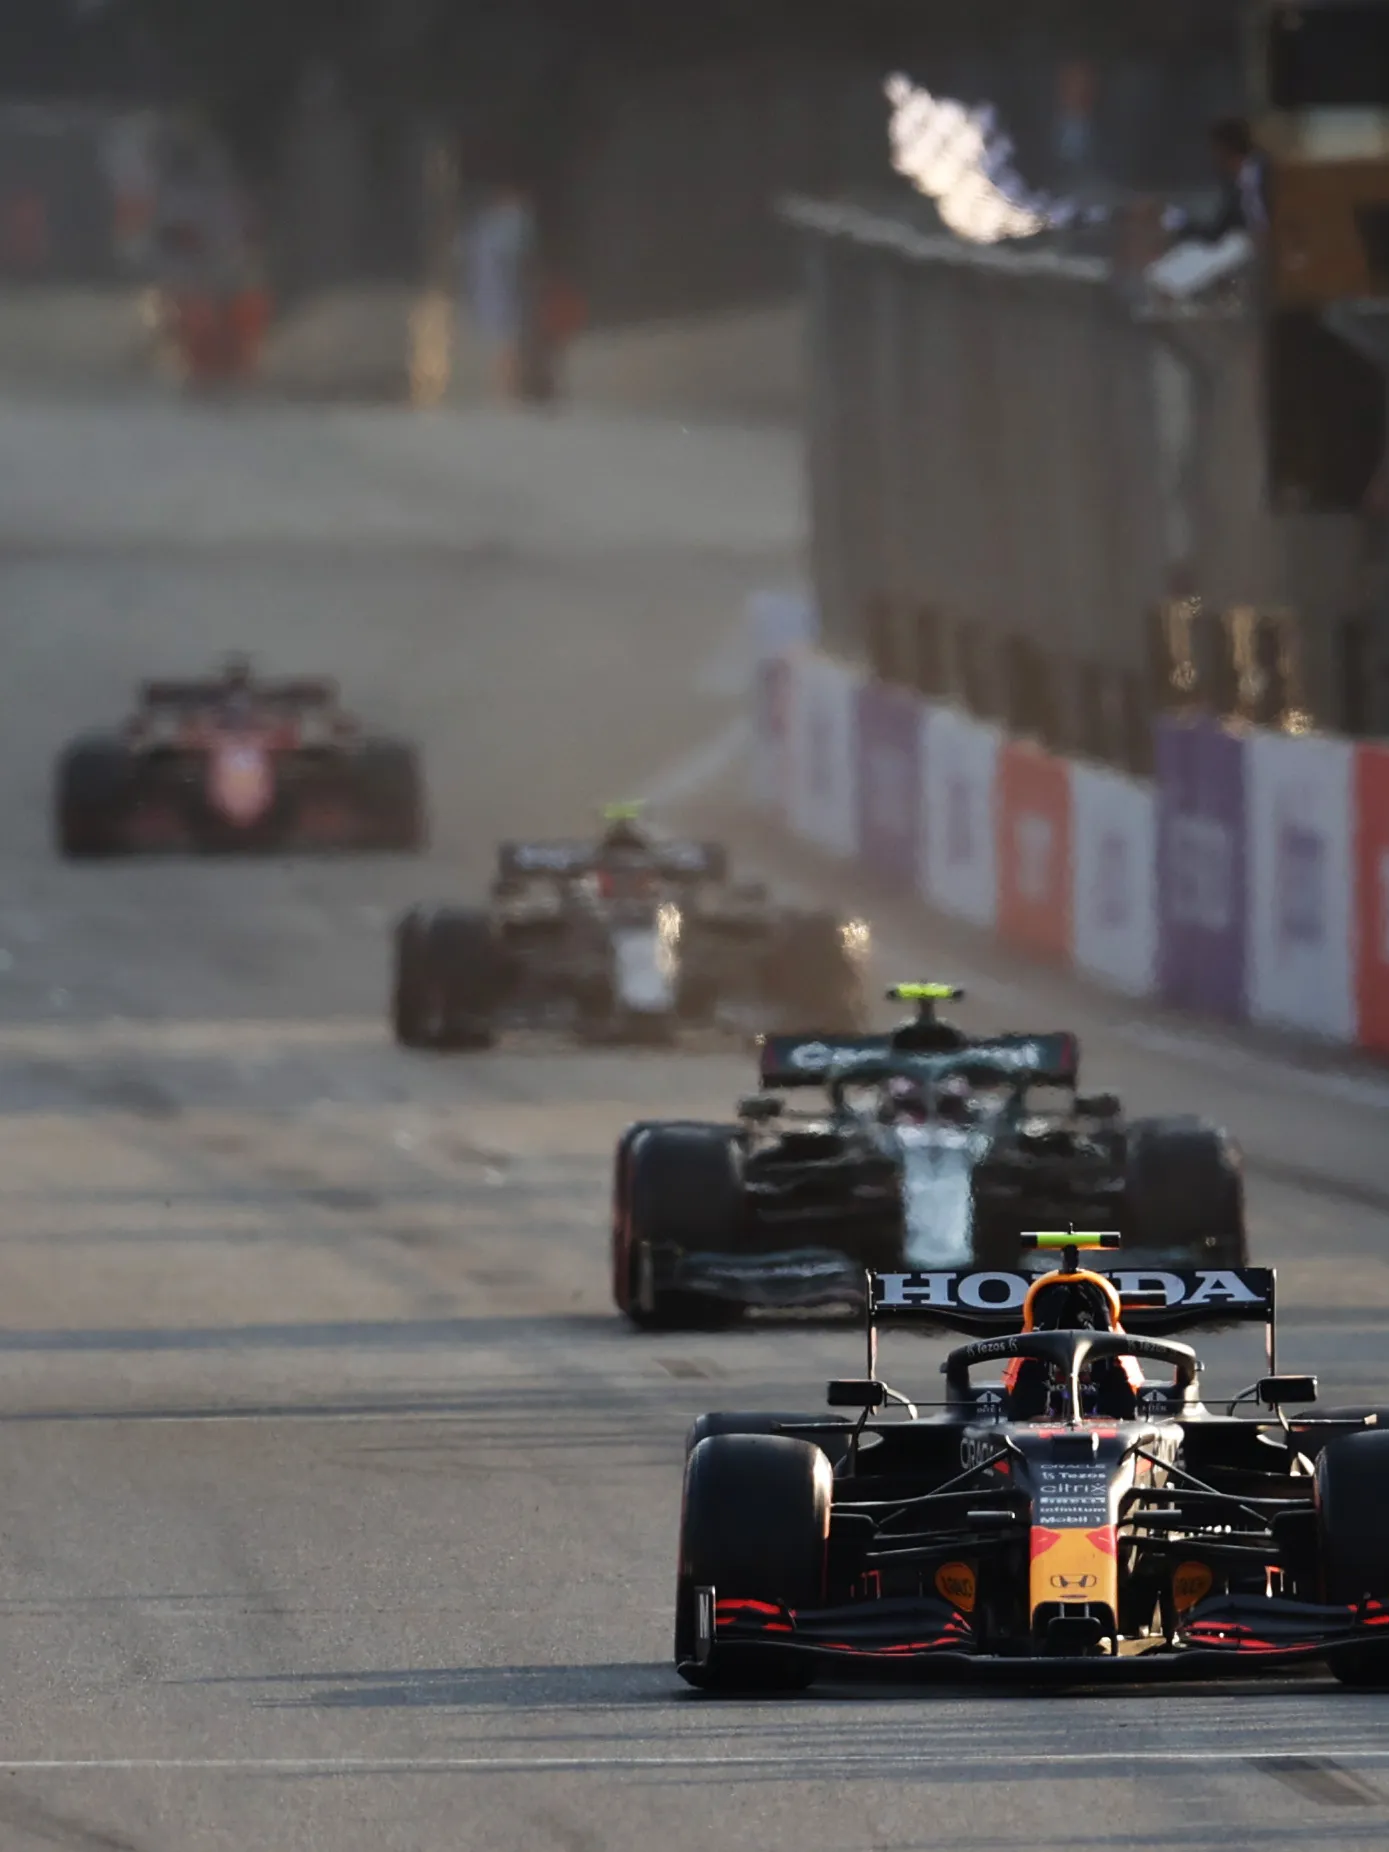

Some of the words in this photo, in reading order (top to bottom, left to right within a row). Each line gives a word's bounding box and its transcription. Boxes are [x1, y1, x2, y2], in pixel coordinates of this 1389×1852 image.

[877, 1271, 1266, 1309] HODA
[1059, 1471, 1106, 1480] Tezos
[1040, 1482, 1106, 1494] citrix
[1040, 1515, 1088, 1524] Mobil
